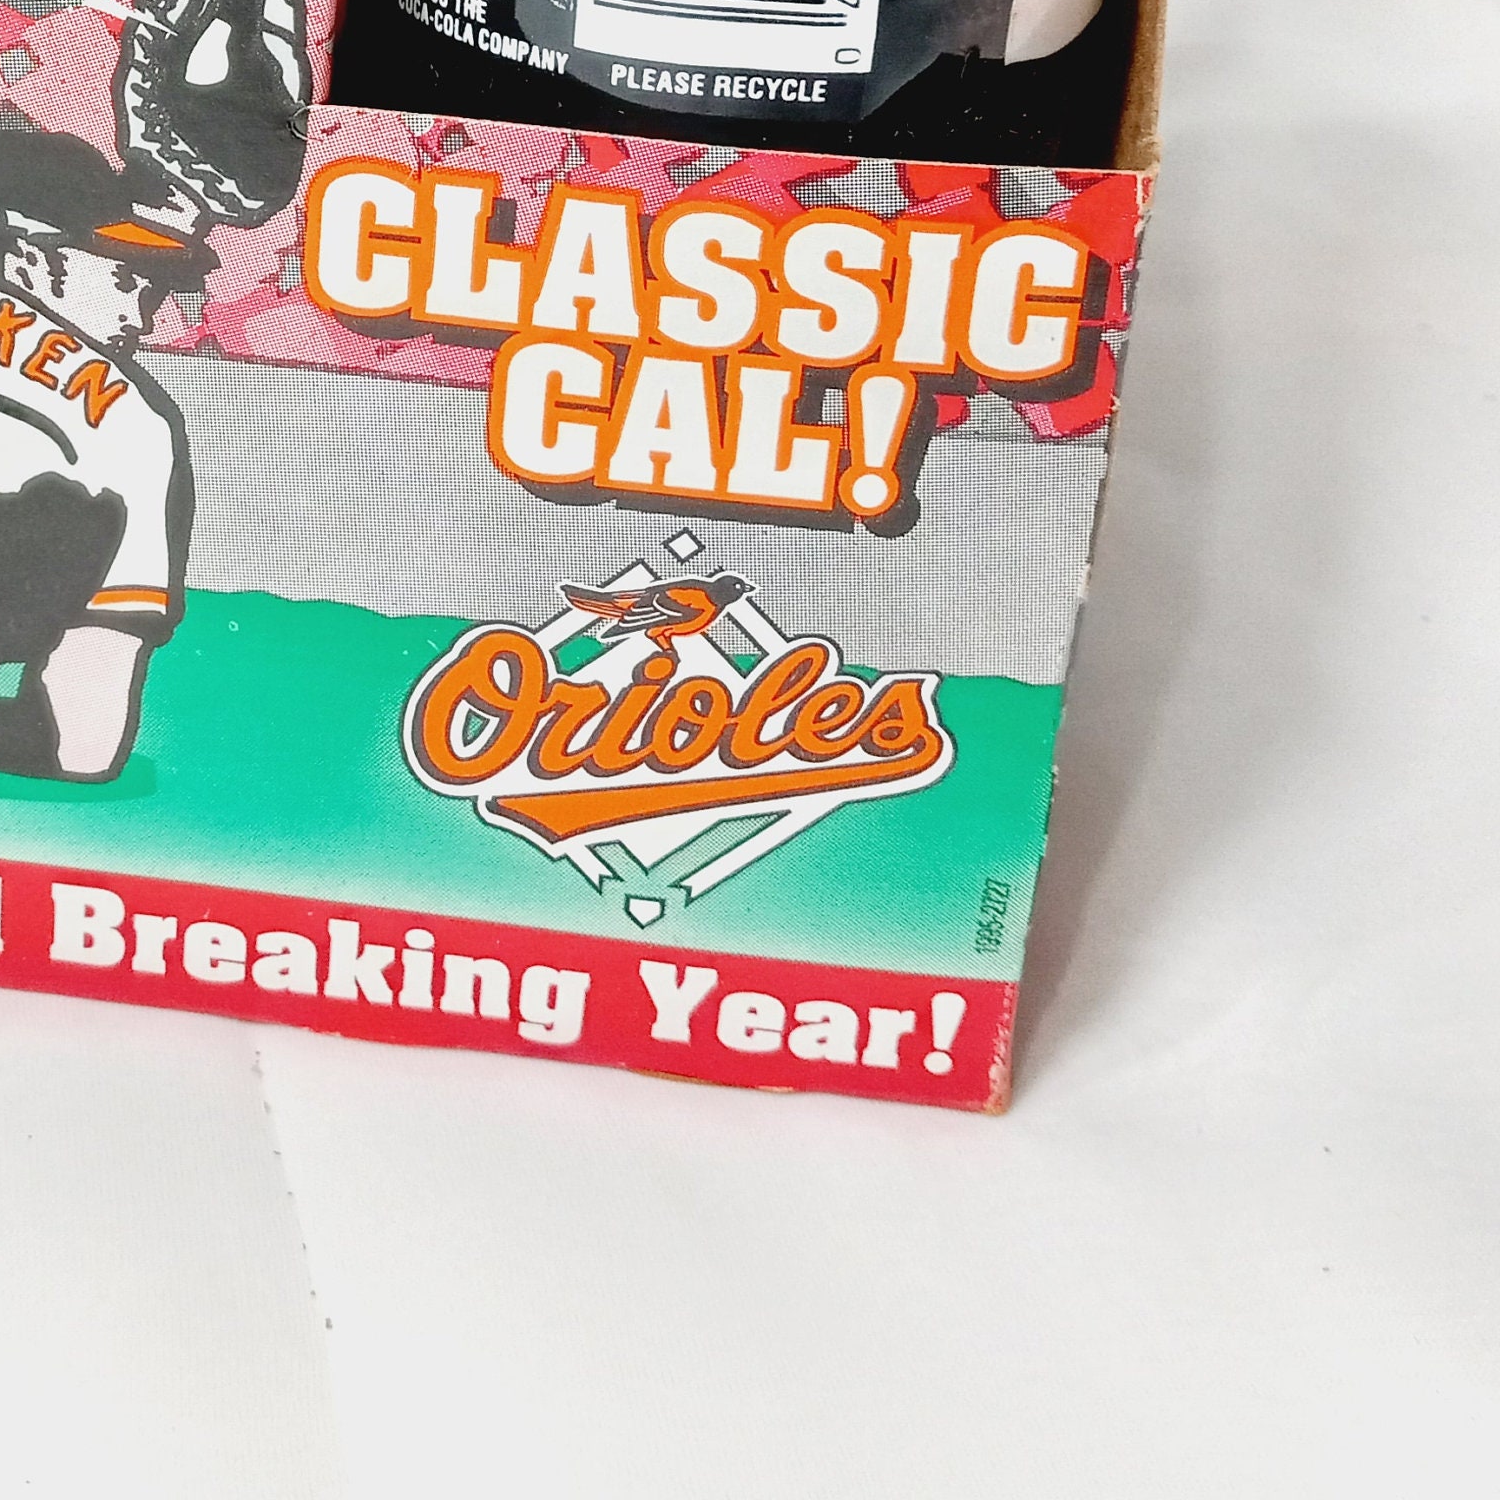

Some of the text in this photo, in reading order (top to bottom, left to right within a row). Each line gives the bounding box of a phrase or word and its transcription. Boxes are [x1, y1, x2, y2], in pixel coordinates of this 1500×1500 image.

[478, 28, 569, 75] COMPANY
[611, 63, 828, 103] PLEASE RECYCLE
[310, 164, 1084, 376] CLASSIC
[496, 340, 912, 511] CAL!
[414, 629, 945, 787] Orioles
[50, 882, 591, 1047] Breaking
[639, 959, 968, 1075] Year!
